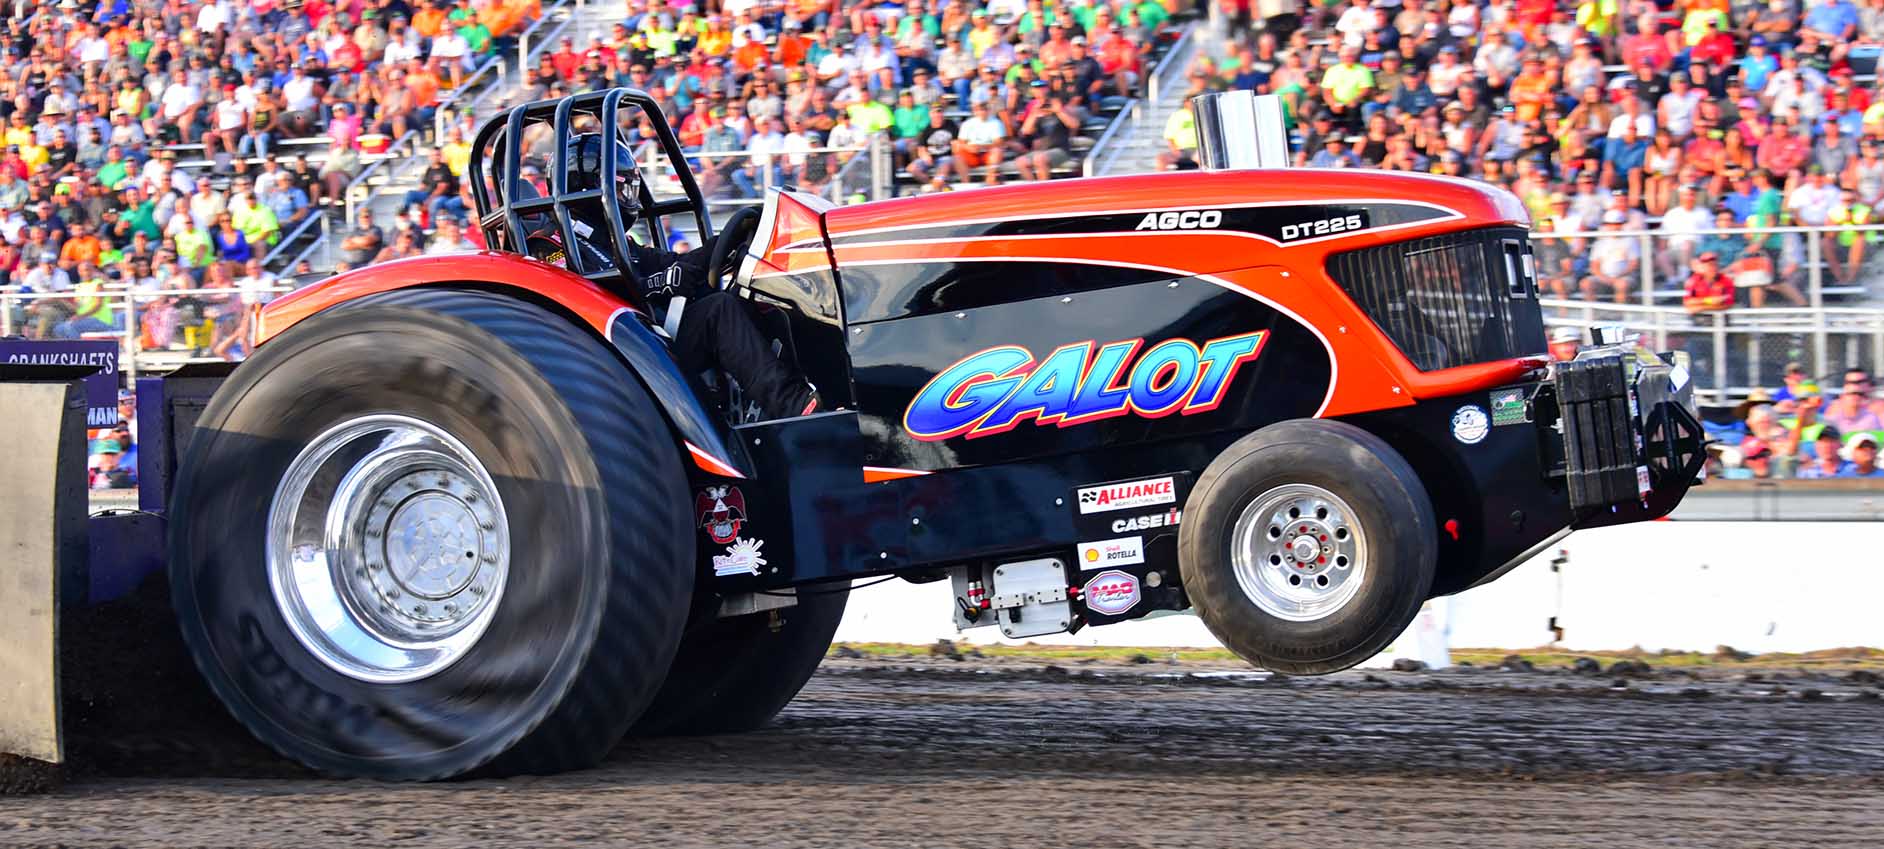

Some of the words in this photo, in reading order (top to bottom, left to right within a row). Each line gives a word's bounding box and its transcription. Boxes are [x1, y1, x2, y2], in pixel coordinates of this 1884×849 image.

[1135, 210, 1222, 231] AGCO
[1281, 214, 1362, 240] DT225
[903, 329, 1270, 441] GALOT
[1097, 481, 1171, 505] ALLIANCE
[1112, 514, 1163, 533] CASE
[1107, 550, 1136, 560] ROTELLA
